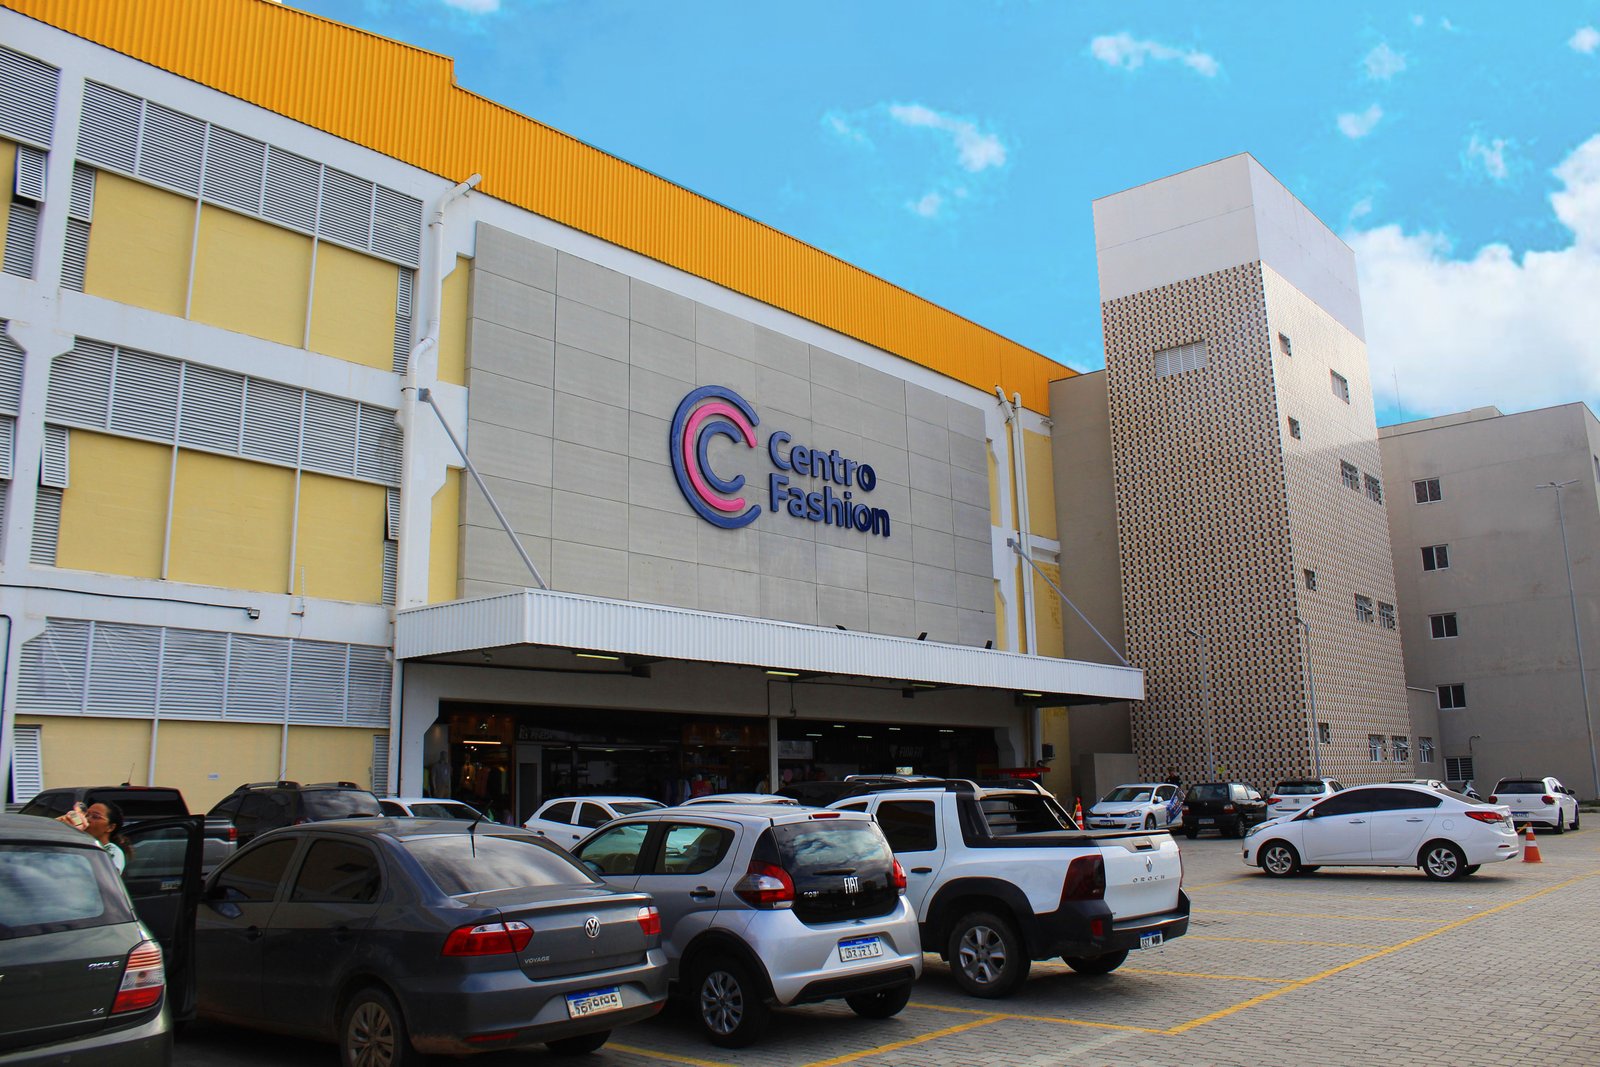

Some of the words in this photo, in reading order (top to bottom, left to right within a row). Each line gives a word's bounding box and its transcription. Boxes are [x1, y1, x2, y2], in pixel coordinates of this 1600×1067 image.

[768, 430, 877, 492] Centro
[769, 472, 891, 537] Fashion
[843, 876, 859, 894] FIAT
[1132, 874, 1165, 883] OROCH
[524, 955, 550, 964] VOYAGE
